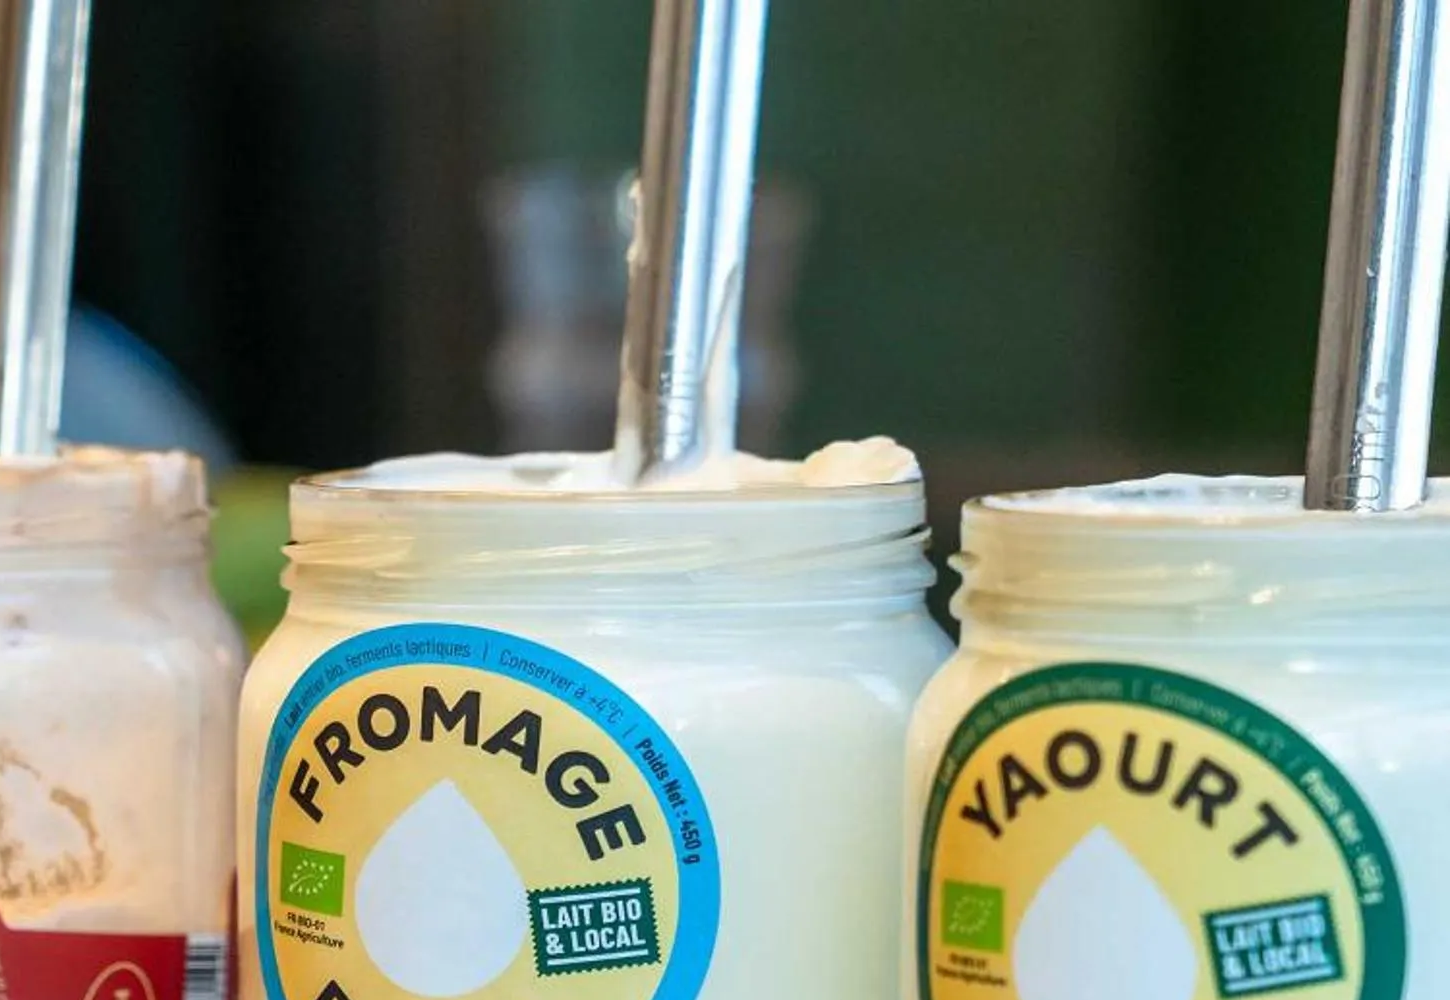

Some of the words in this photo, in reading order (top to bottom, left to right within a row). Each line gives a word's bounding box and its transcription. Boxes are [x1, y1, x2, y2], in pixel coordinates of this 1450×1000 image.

[405, 638, 472, 659] lactiques
[500, 648, 577, 693] Conserver
[289, 686, 647, 861] FROMAGE
[633, 737, 670, 781] Poids
[661, 778, 688, 810] Net
[678, 817, 703, 852] 450
[960, 729, 1300, 860] YAOURT
[541, 904, 594, 931] LAIT
[602, 898, 643, 925] BIO
[1216, 921, 1272, 953] LAIT
[1278, 914, 1326, 942] BIO
[545, 931, 565, 955] &
[571, 920, 646, 951] LOCAL
[1248, 940, 1330, 975] LOCAL
